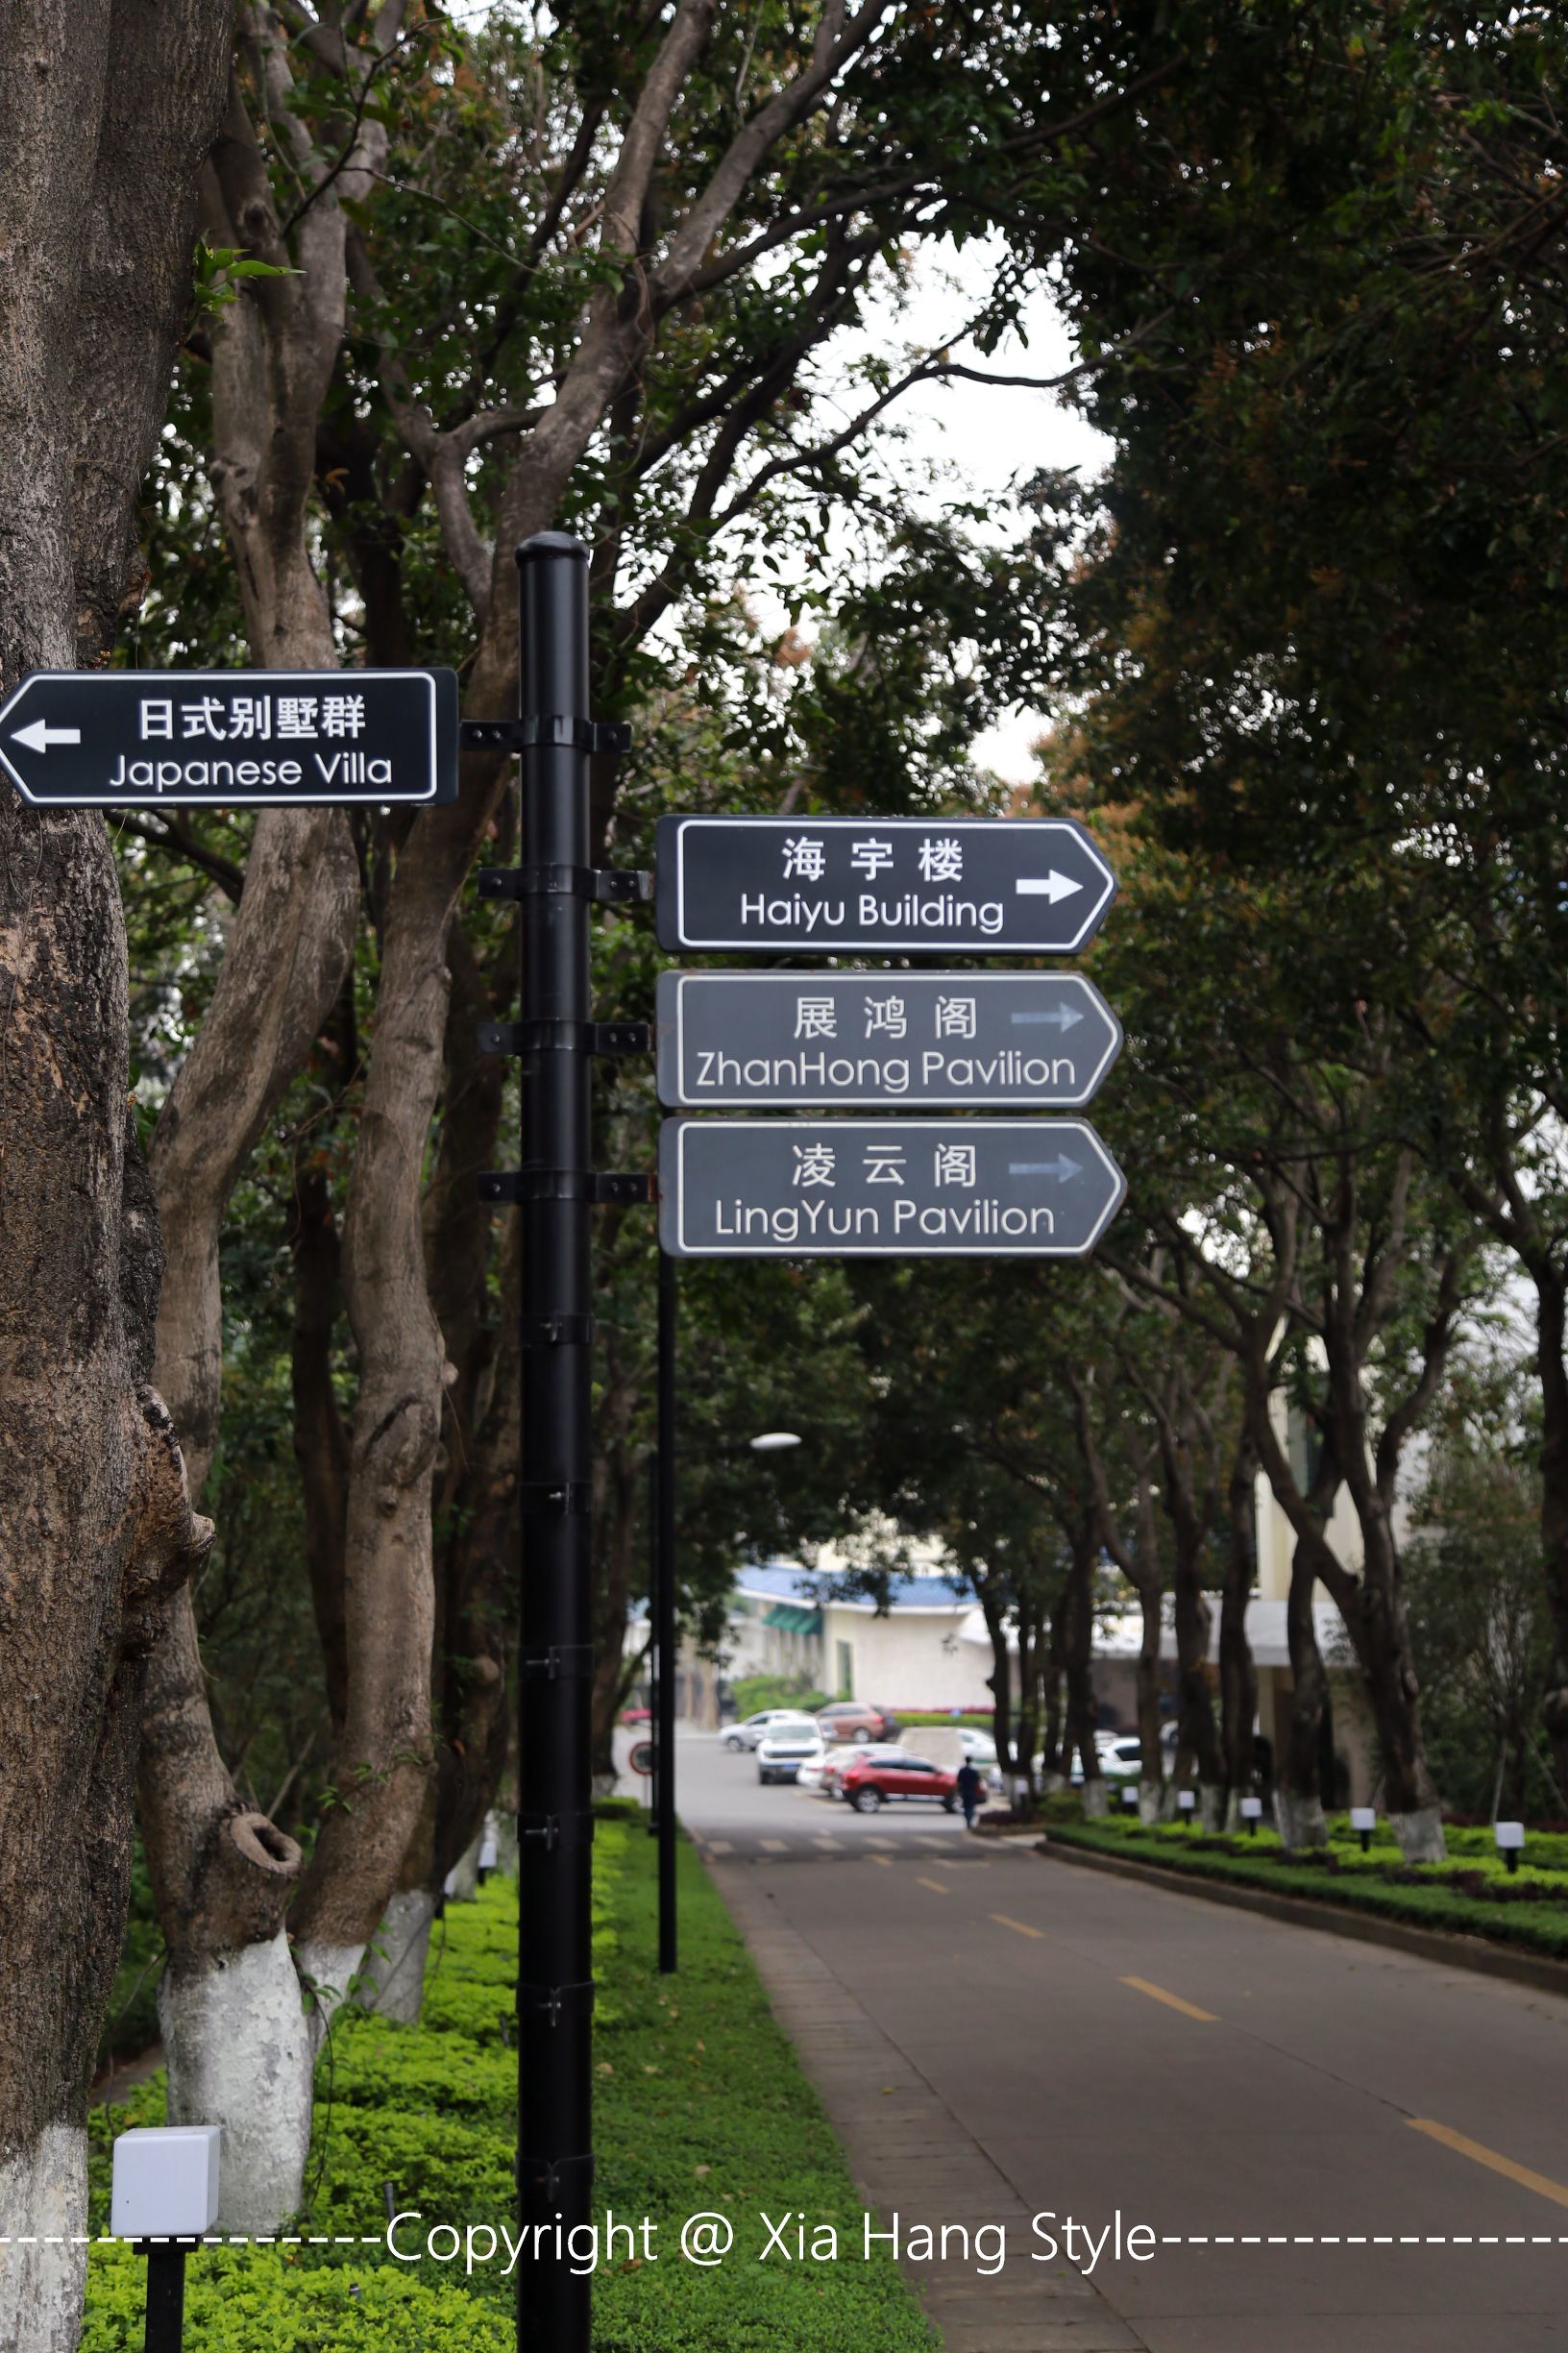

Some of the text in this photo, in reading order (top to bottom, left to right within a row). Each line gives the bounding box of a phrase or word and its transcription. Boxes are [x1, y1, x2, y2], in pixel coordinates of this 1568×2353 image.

[140, 694, 366, 741] 日式别墅群
[109, 751, 392, 794] Japanese Villa
[781, 836, 964, 882] 海宇楼
[741, 893, 1004, 935] Haiyu Building
[794, 994, 977, 1040] 展鸿阁
[696, 1049, 1076, 1094] ZhanHong Pavilion
[792, 1142, 976, 1188] 凌云阁
[716, 1198, 1055, 1242] LingYun Pavilion
